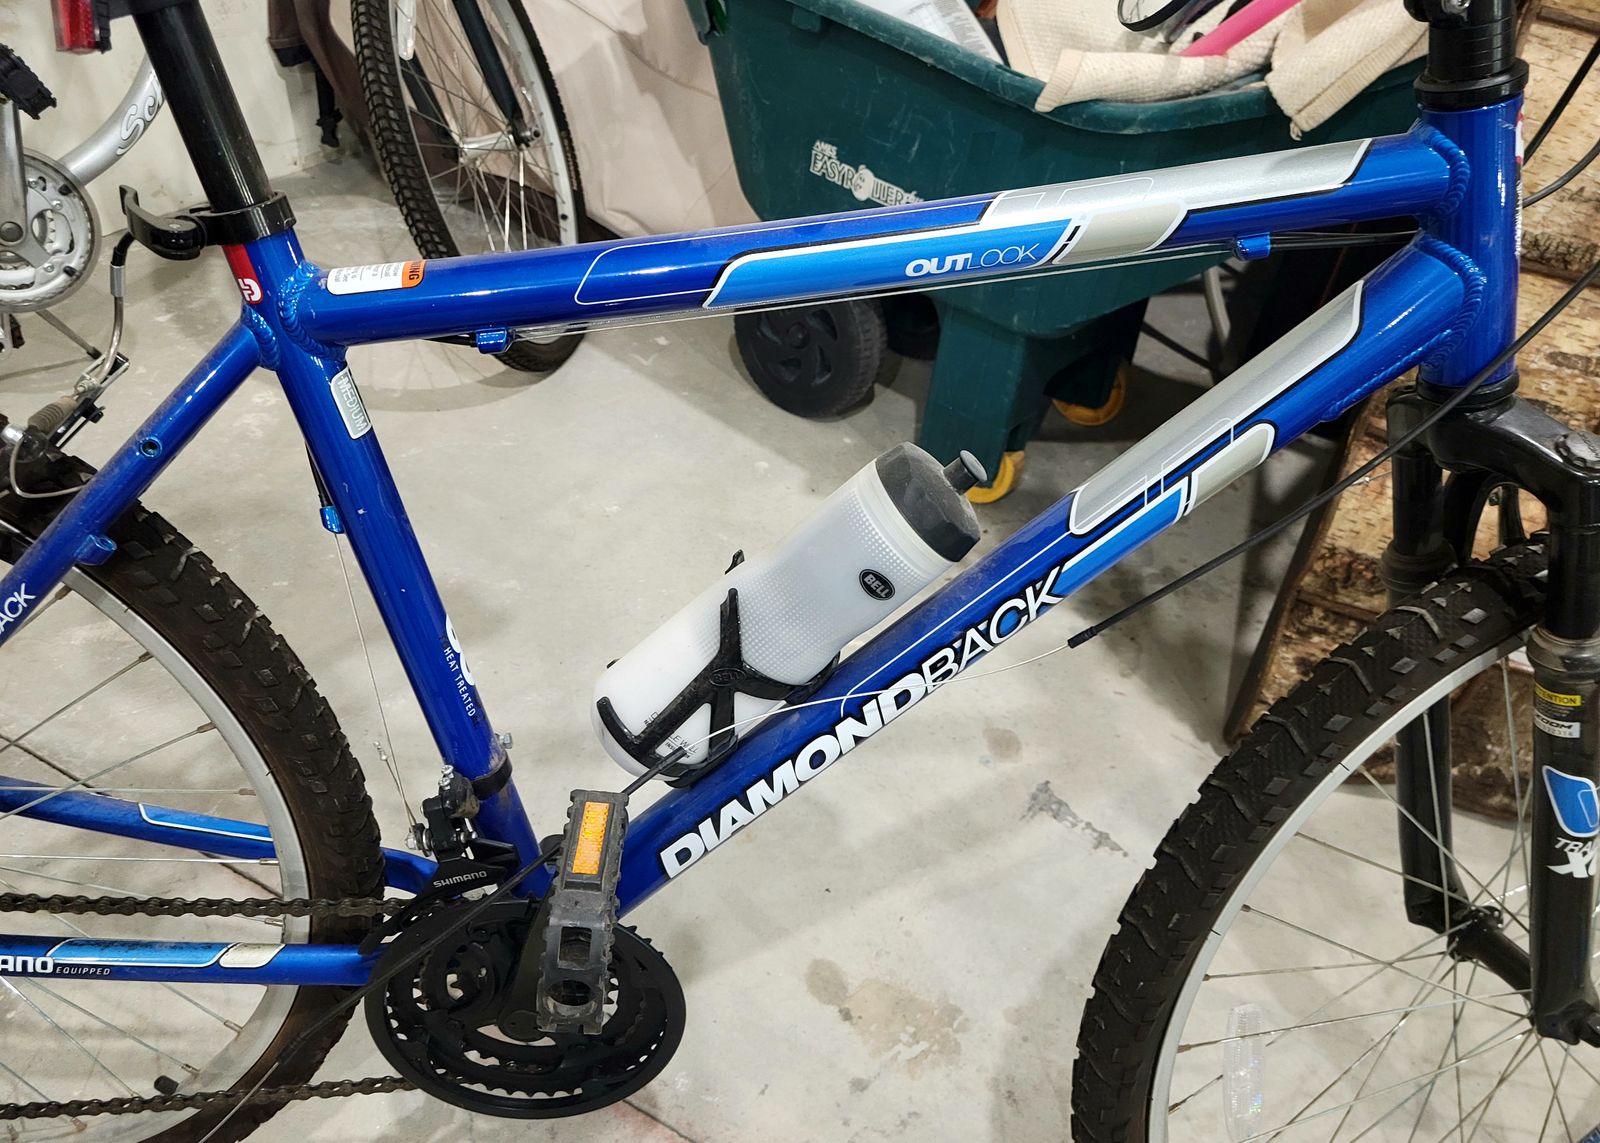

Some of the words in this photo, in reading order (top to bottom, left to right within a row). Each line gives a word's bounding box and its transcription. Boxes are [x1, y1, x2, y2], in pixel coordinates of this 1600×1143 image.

[905, 243, 1040, 277] OUTLOOK
[337, 374, 368, 431] MEDIUM
[863, 573, 890, 598] BELL
[444, 646, 459, 672] HEAT
[455, 674, 476, 717] TREATED
[660, 567, 1064, 879] DIAMONDBACK
[432, 870, 488, 888] SHIMANO
[55, 966, 111, 976] EQUIPPED
